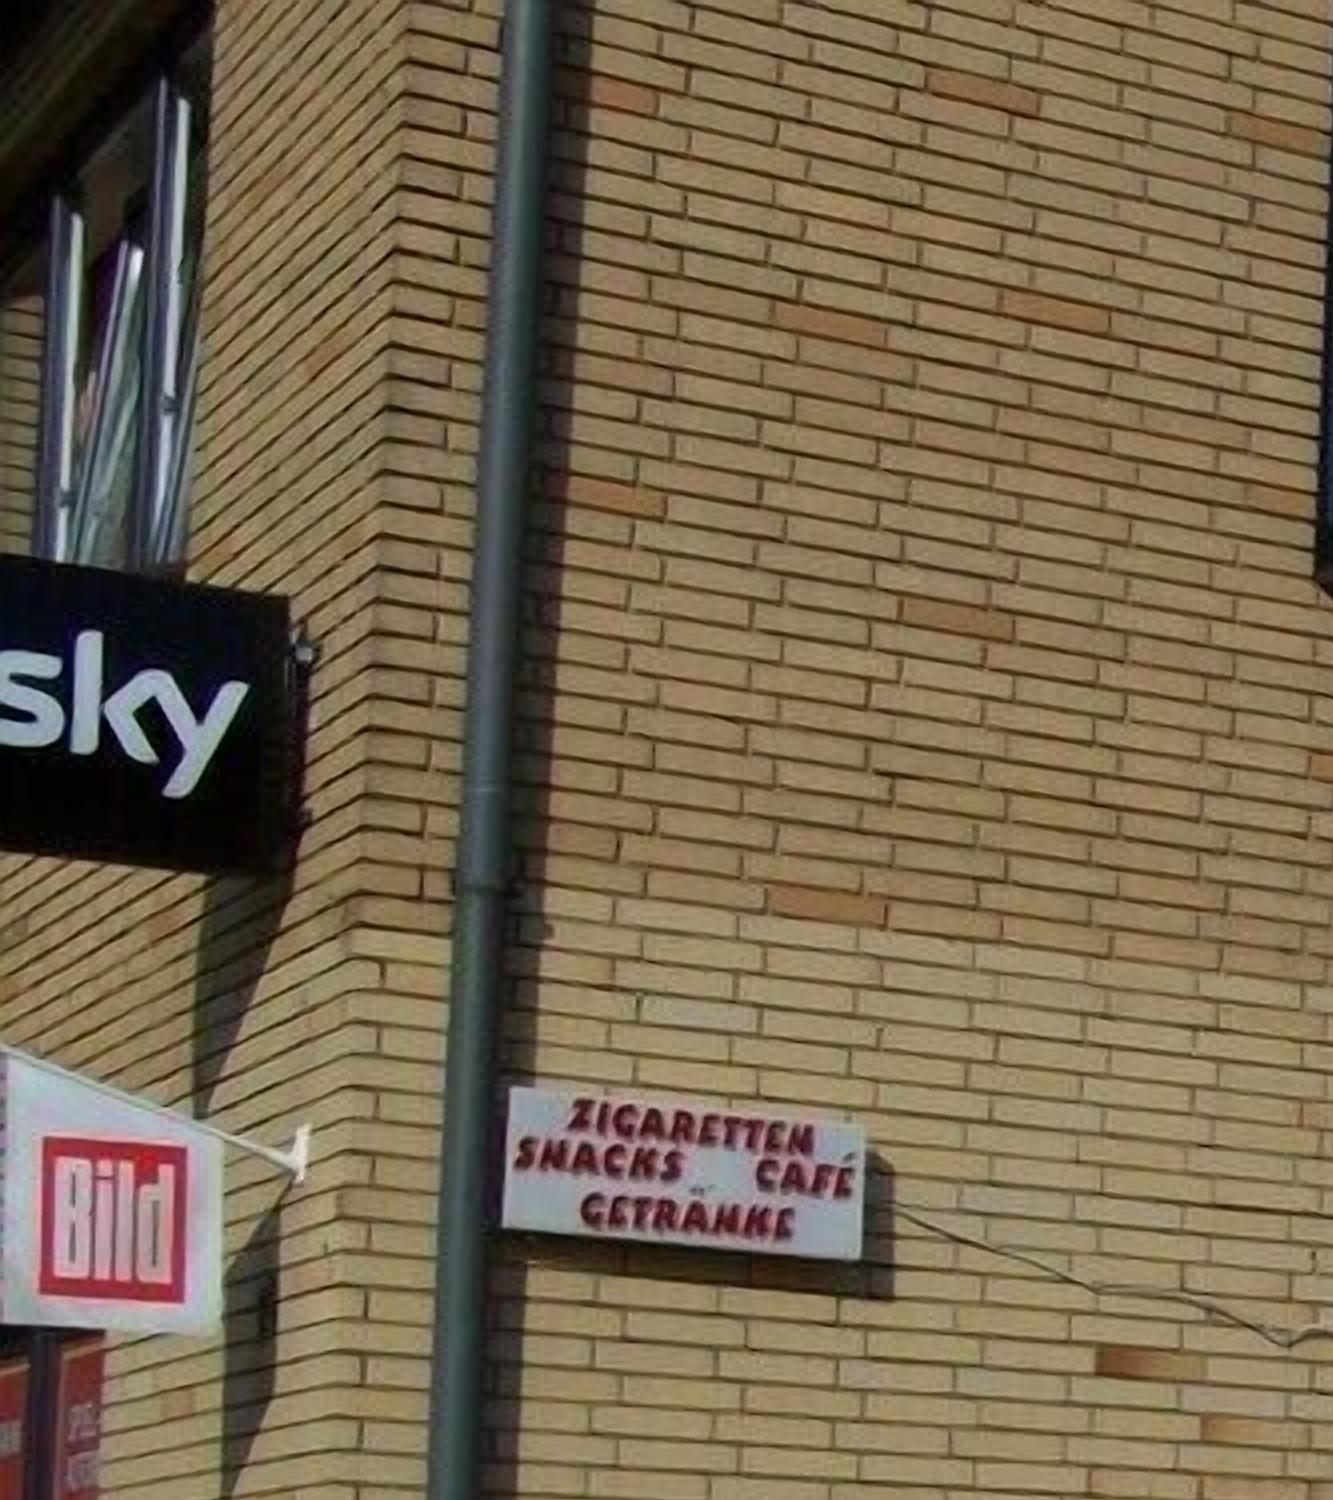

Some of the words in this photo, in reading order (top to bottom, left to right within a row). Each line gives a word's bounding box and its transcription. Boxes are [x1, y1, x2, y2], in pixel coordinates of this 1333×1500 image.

[0, 629, 249, 798] sky
[567, 1098, 816, 1156] ZIGARETTEN
[513, 1136, 687, 1183] SNACKS
[53, 1155, 176, 1285] Bild
[580, 1185, 797, 1242] GETRÄNKE
